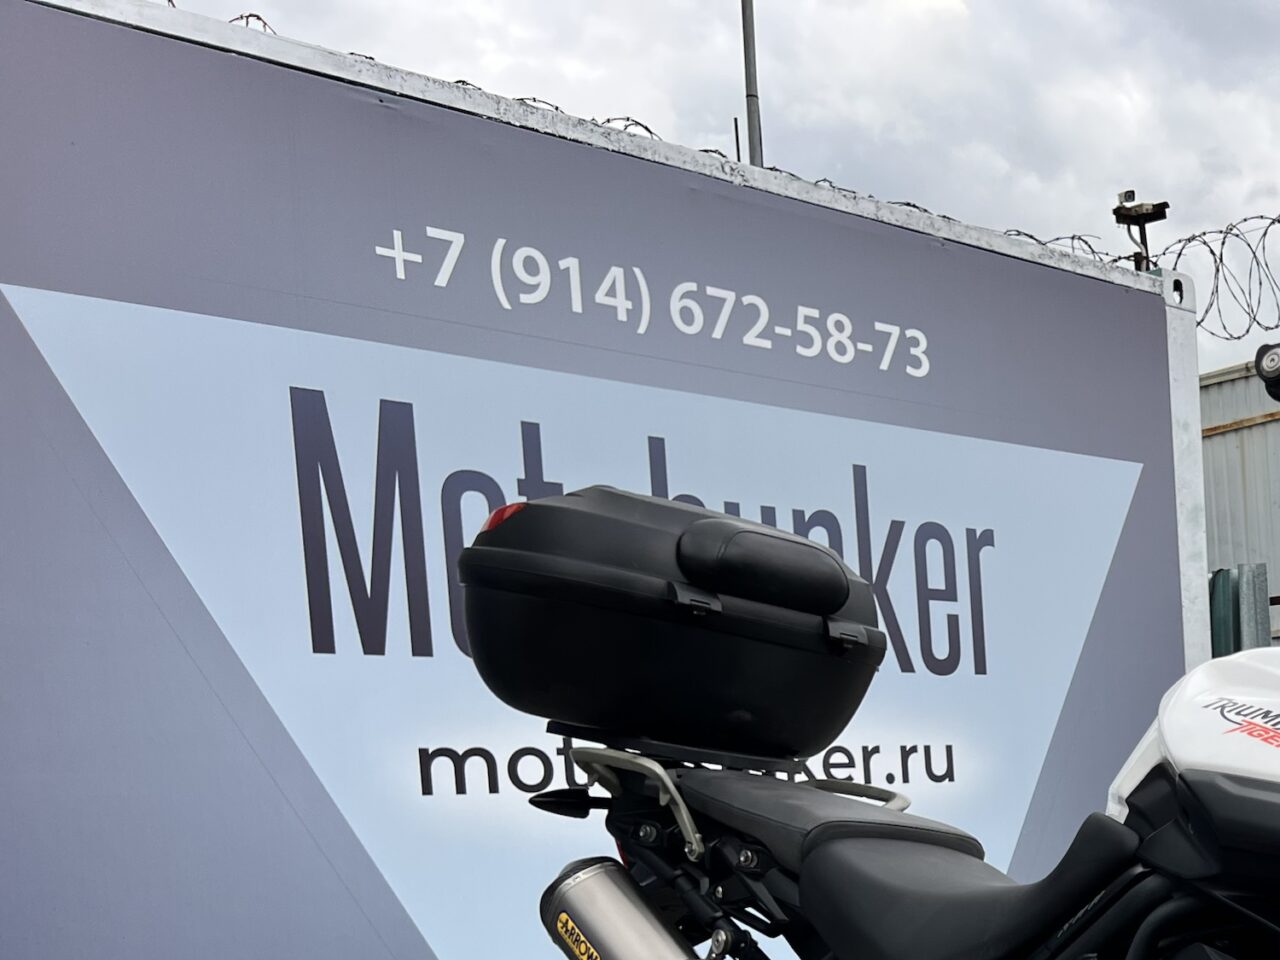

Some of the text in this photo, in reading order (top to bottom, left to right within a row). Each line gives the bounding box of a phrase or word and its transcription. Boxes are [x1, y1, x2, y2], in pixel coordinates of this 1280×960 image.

[375, 225, 930, 378] +7 (914) 672-58-73
[288, 385, 996, 675] Moker
[419, 737, 955, 796] moter.ru
